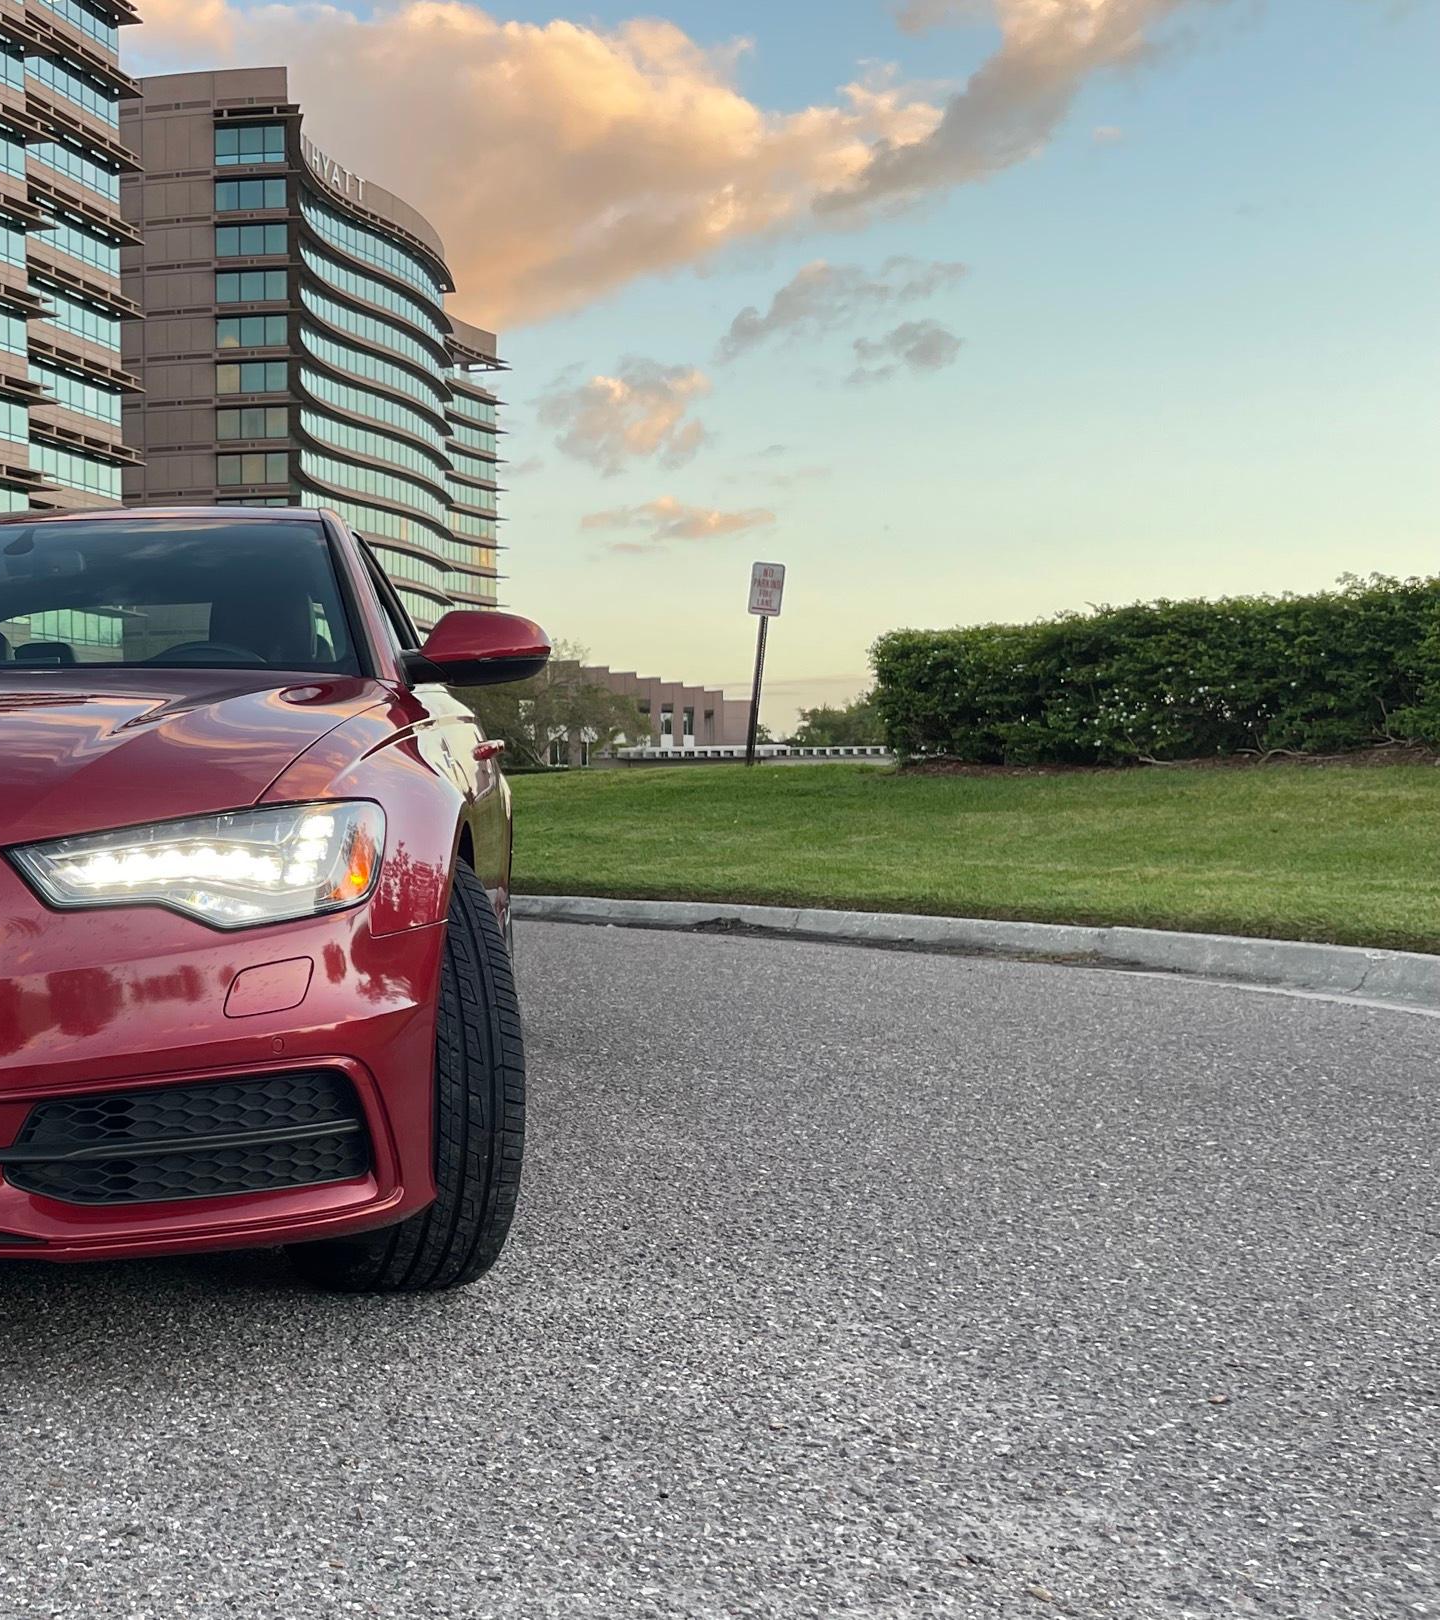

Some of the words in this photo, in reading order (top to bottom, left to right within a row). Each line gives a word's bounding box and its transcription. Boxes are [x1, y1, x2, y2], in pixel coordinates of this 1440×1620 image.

[312, 145, 365, 200] HYATT
[763, 567, 774, 578] NO
[753, 578, 781, 590] PARKING
